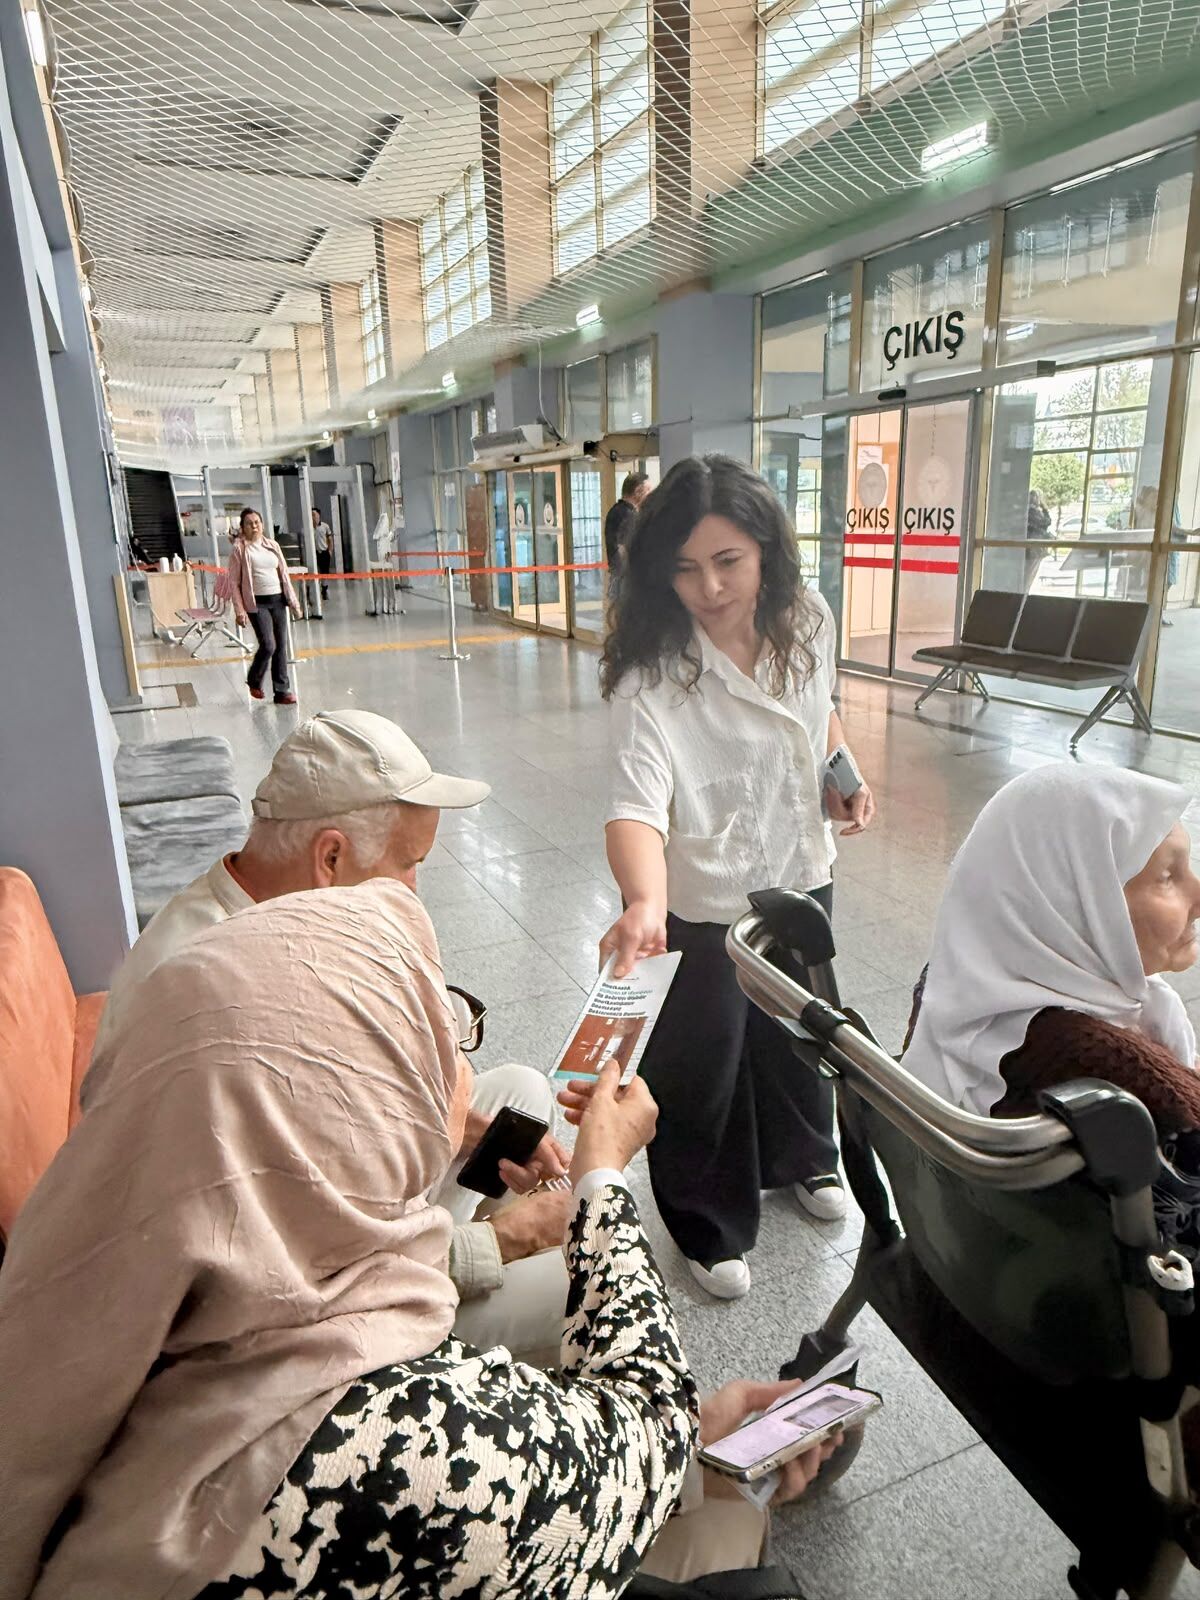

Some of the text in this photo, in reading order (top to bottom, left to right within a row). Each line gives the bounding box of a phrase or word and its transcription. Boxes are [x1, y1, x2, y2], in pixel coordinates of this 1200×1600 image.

[884, 311, 963, 370] ÇIKIŞ
[847, 507, 890, 533] ÇIKIŞ
[904, 507, 955, 535] ÇIKIŞ
